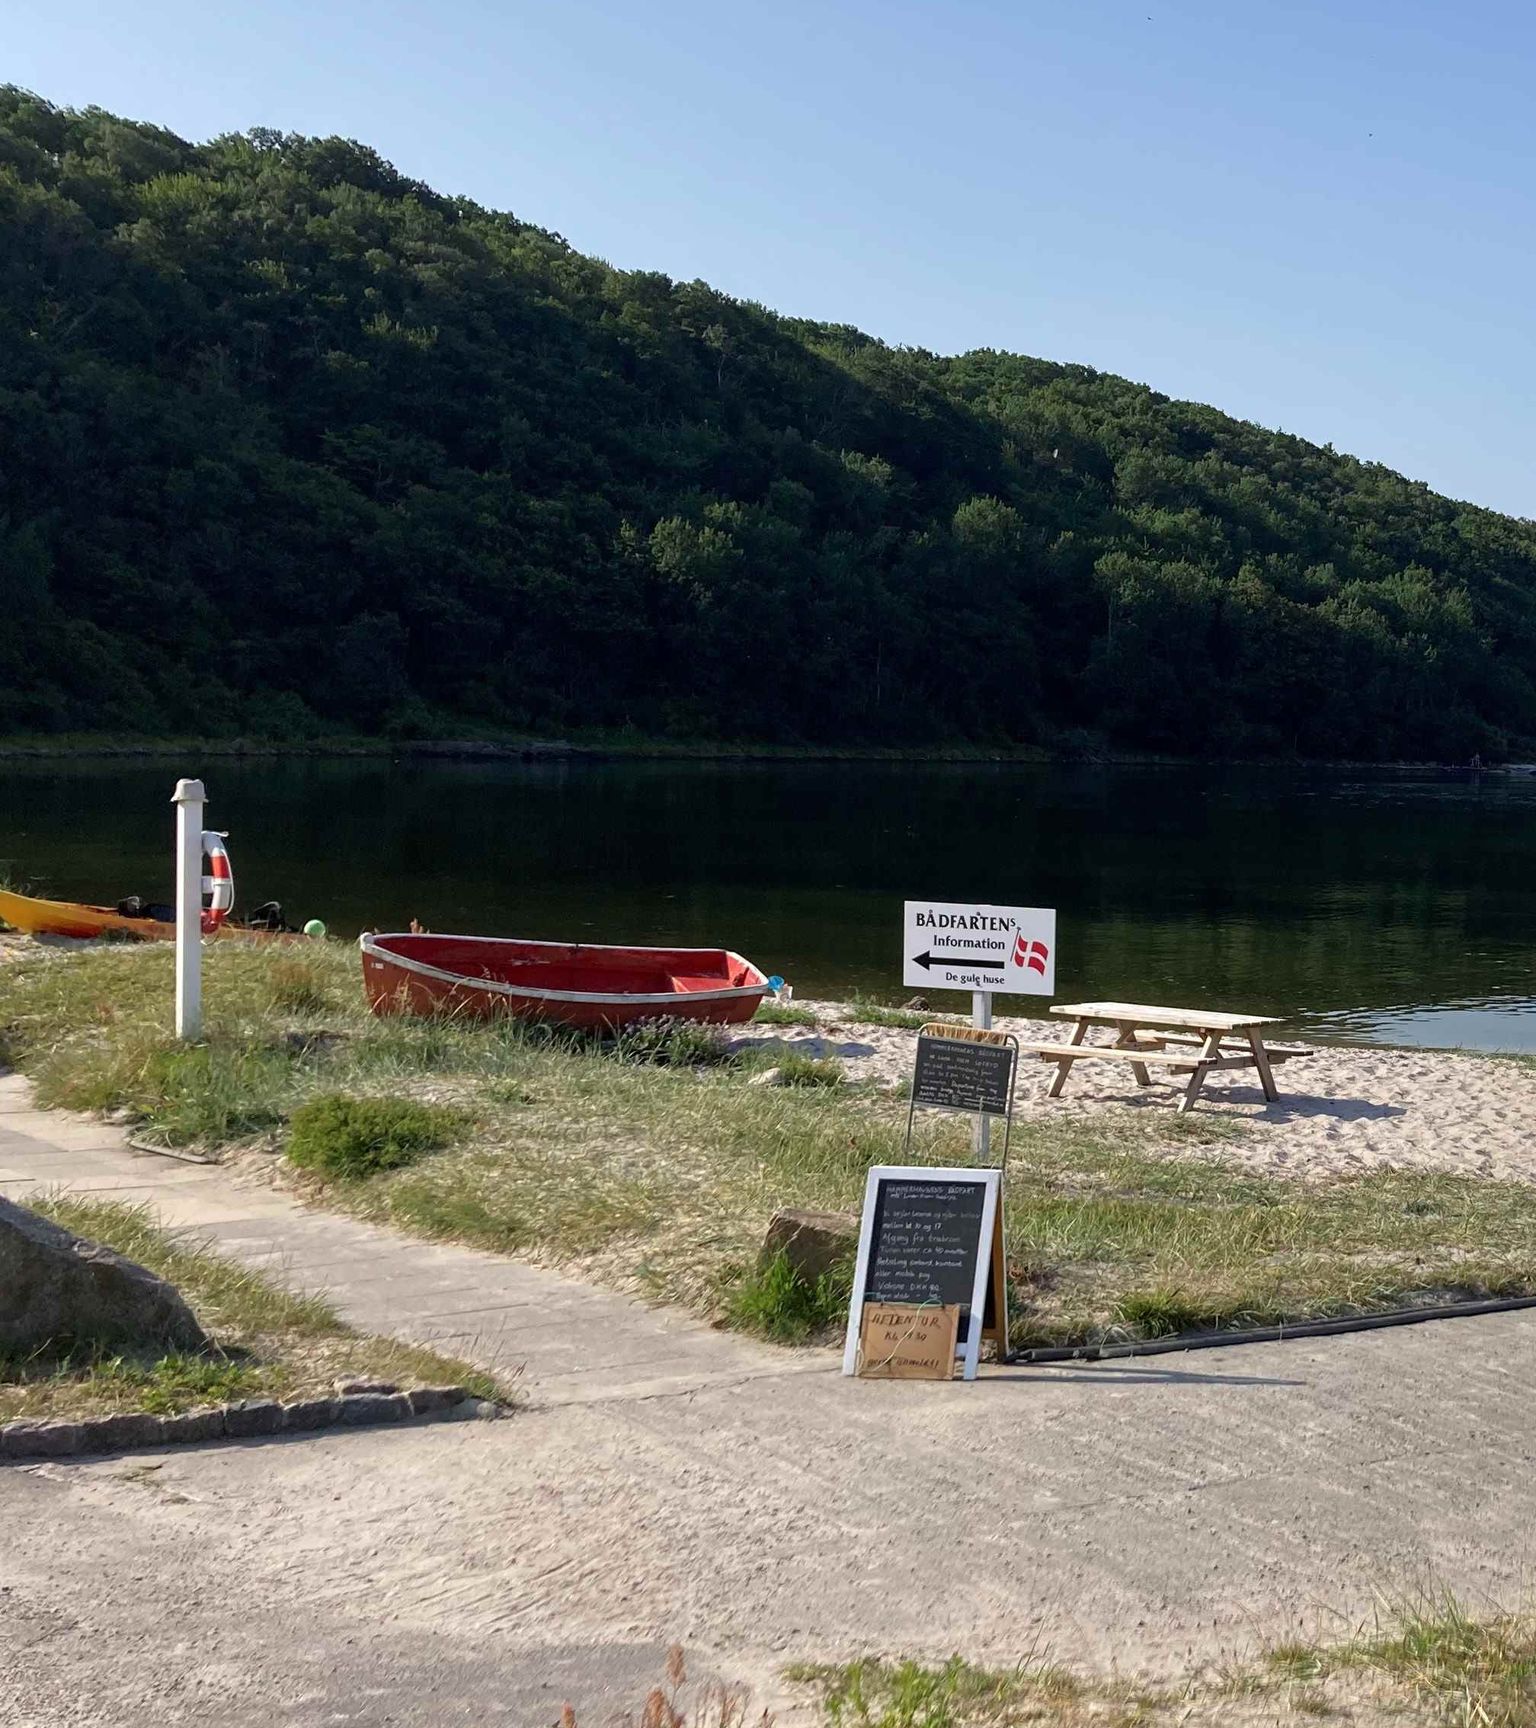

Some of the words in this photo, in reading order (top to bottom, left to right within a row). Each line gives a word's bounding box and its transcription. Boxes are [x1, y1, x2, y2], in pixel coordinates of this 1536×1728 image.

[933, 934, 1005, 950] Information
[945, 972, 958, 981] De
[960, 974, 980, 984] gule
[983, 974, 1005, 984] huse
